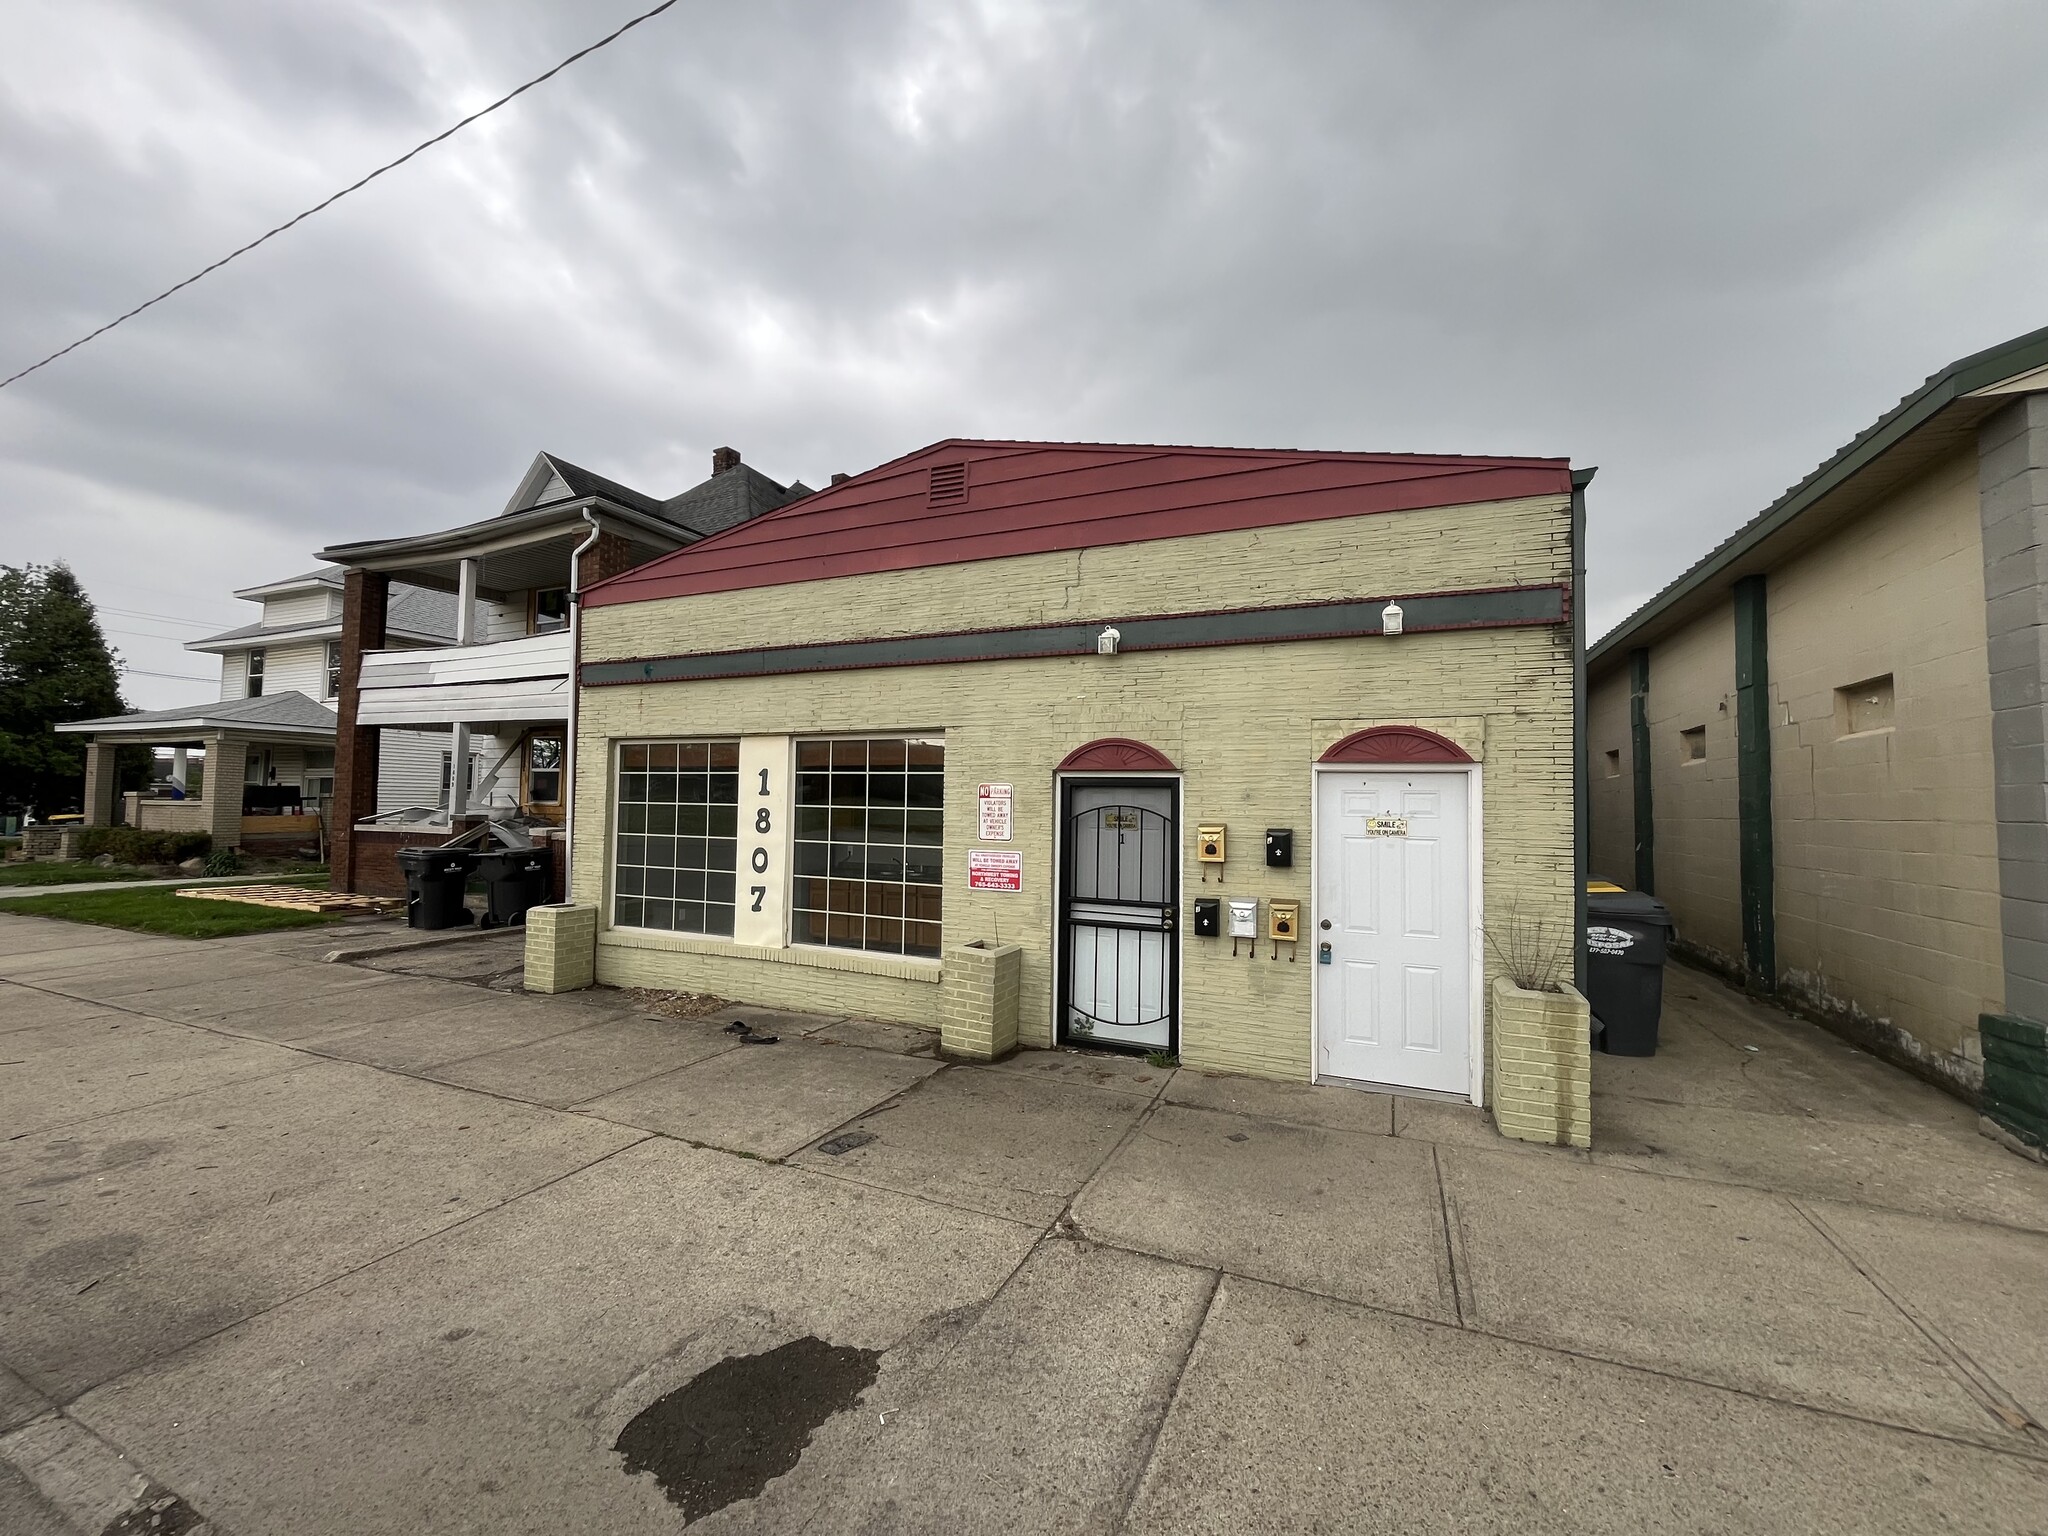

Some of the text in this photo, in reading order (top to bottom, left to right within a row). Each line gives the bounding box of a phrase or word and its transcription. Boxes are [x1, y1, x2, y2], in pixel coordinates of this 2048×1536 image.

[980, 786, 1010, 796] NO PARKING
[750, 768, 771, 912] 1807
